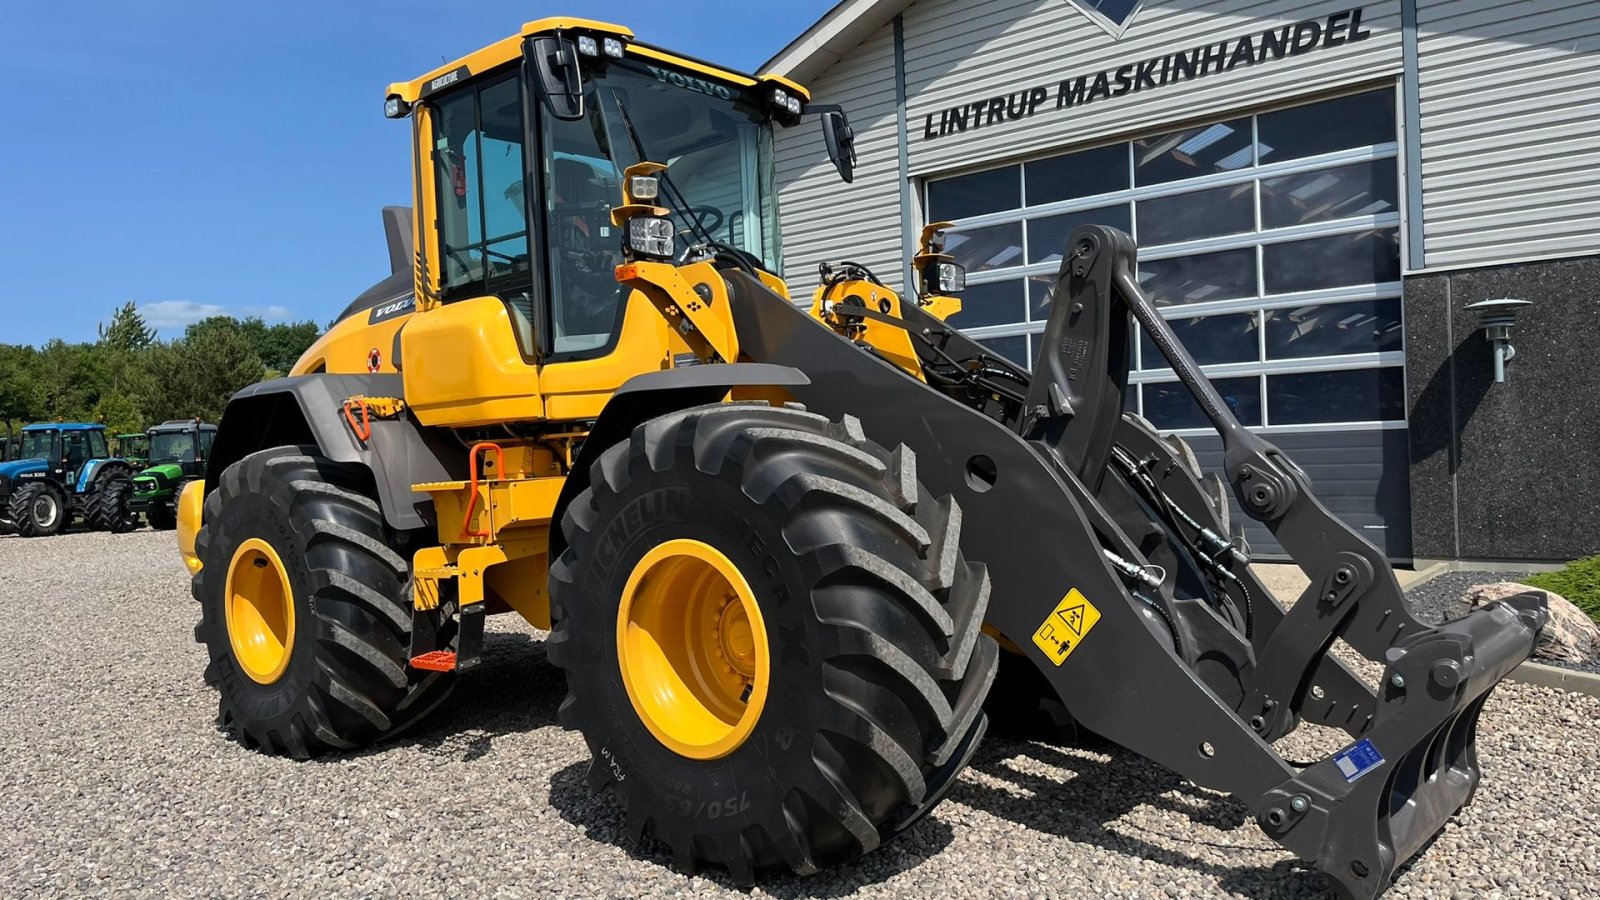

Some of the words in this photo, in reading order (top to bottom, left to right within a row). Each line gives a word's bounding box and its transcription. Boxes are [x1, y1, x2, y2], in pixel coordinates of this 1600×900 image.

[646, 65, 731, 100] VOLVO
[924, 87, 1048, 140] LINTRUP
[1056, 8, 1371, 110] MASKINHANDEL
[376, 298, 417, 318] VOLV
[600, 747, 626, 783] FRAM
